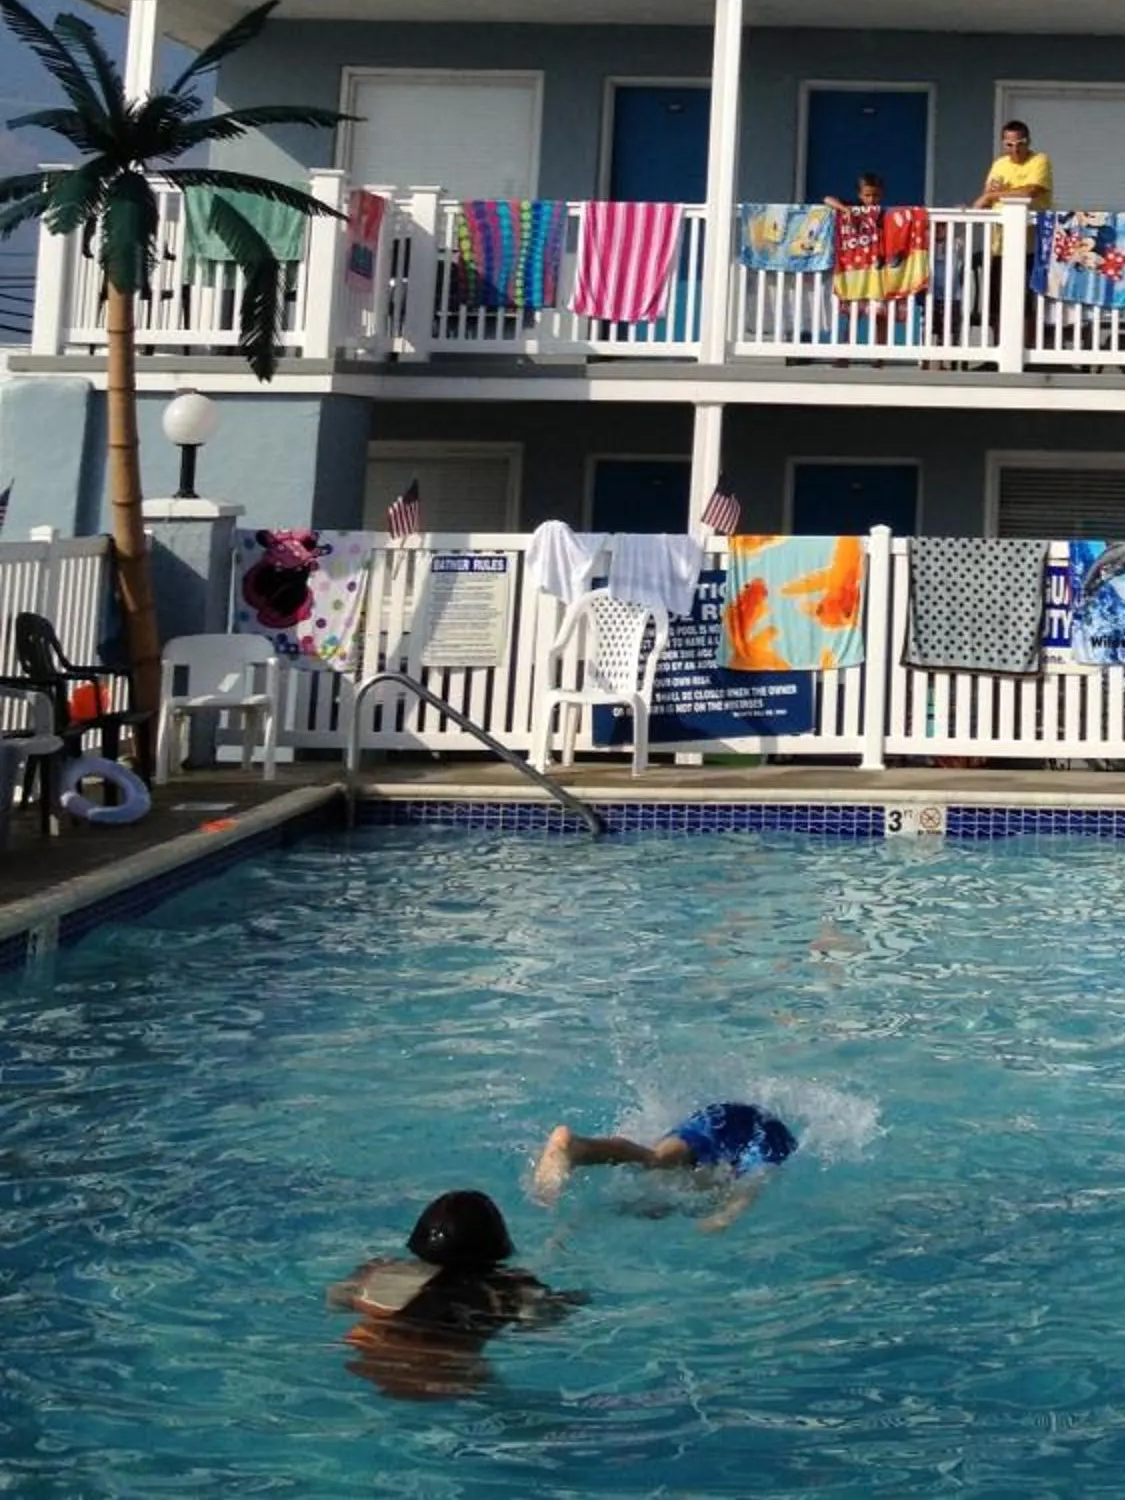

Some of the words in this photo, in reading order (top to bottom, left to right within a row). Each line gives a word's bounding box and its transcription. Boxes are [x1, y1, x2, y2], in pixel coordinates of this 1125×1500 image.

[473, 558, 505, 571] RULES
[768, 683, 798, 696] OWNER
[676, 702, 693, 714] NOT
[694, 701, 707, 712] ON
[887, 809, 903, 833] 3
